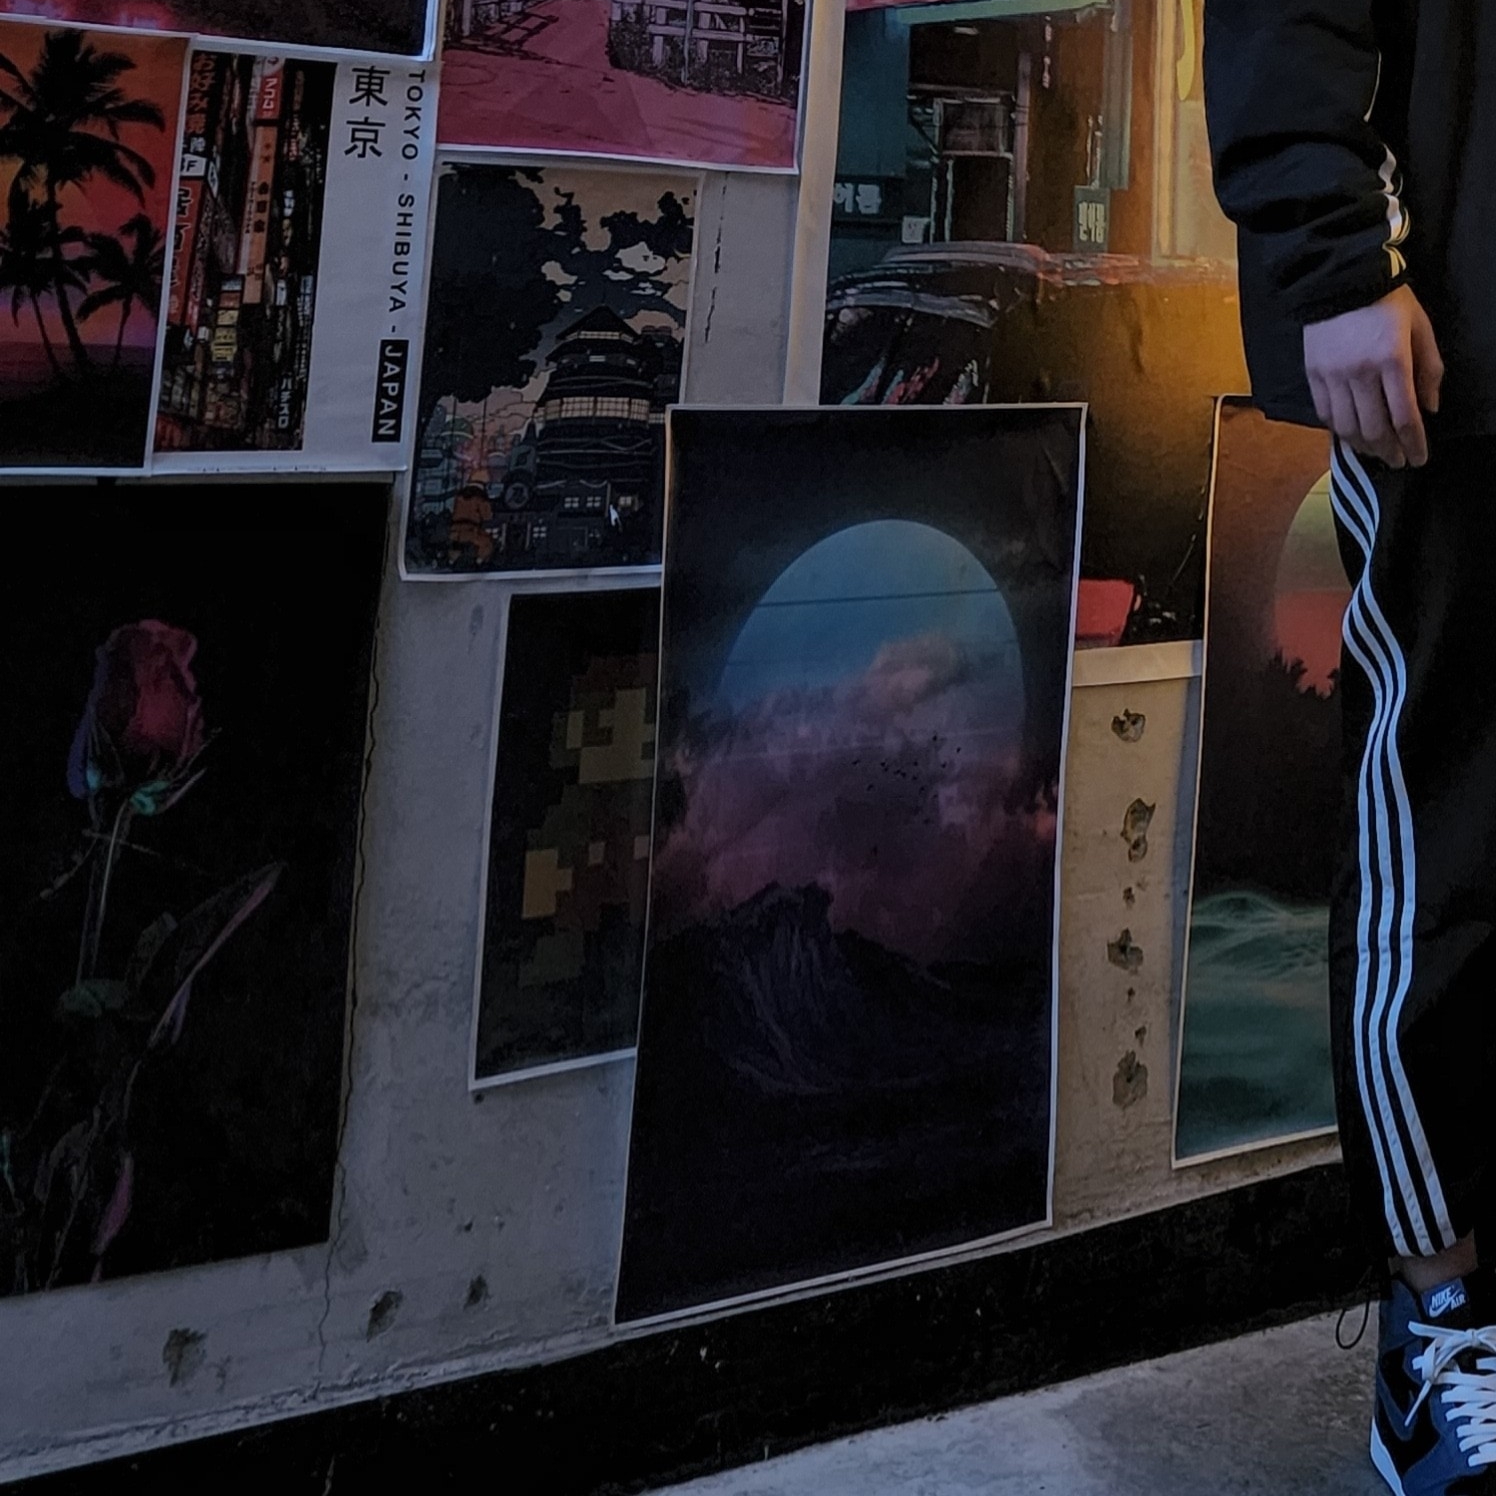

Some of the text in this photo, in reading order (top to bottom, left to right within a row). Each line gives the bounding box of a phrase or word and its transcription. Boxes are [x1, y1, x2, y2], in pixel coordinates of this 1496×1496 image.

[344, 65, 391, 159] 東京
[374, 69, 425, 438] TOKYO SHIBUYA JAPAN
[1431, 1286, 1452, 1308] NIKE
